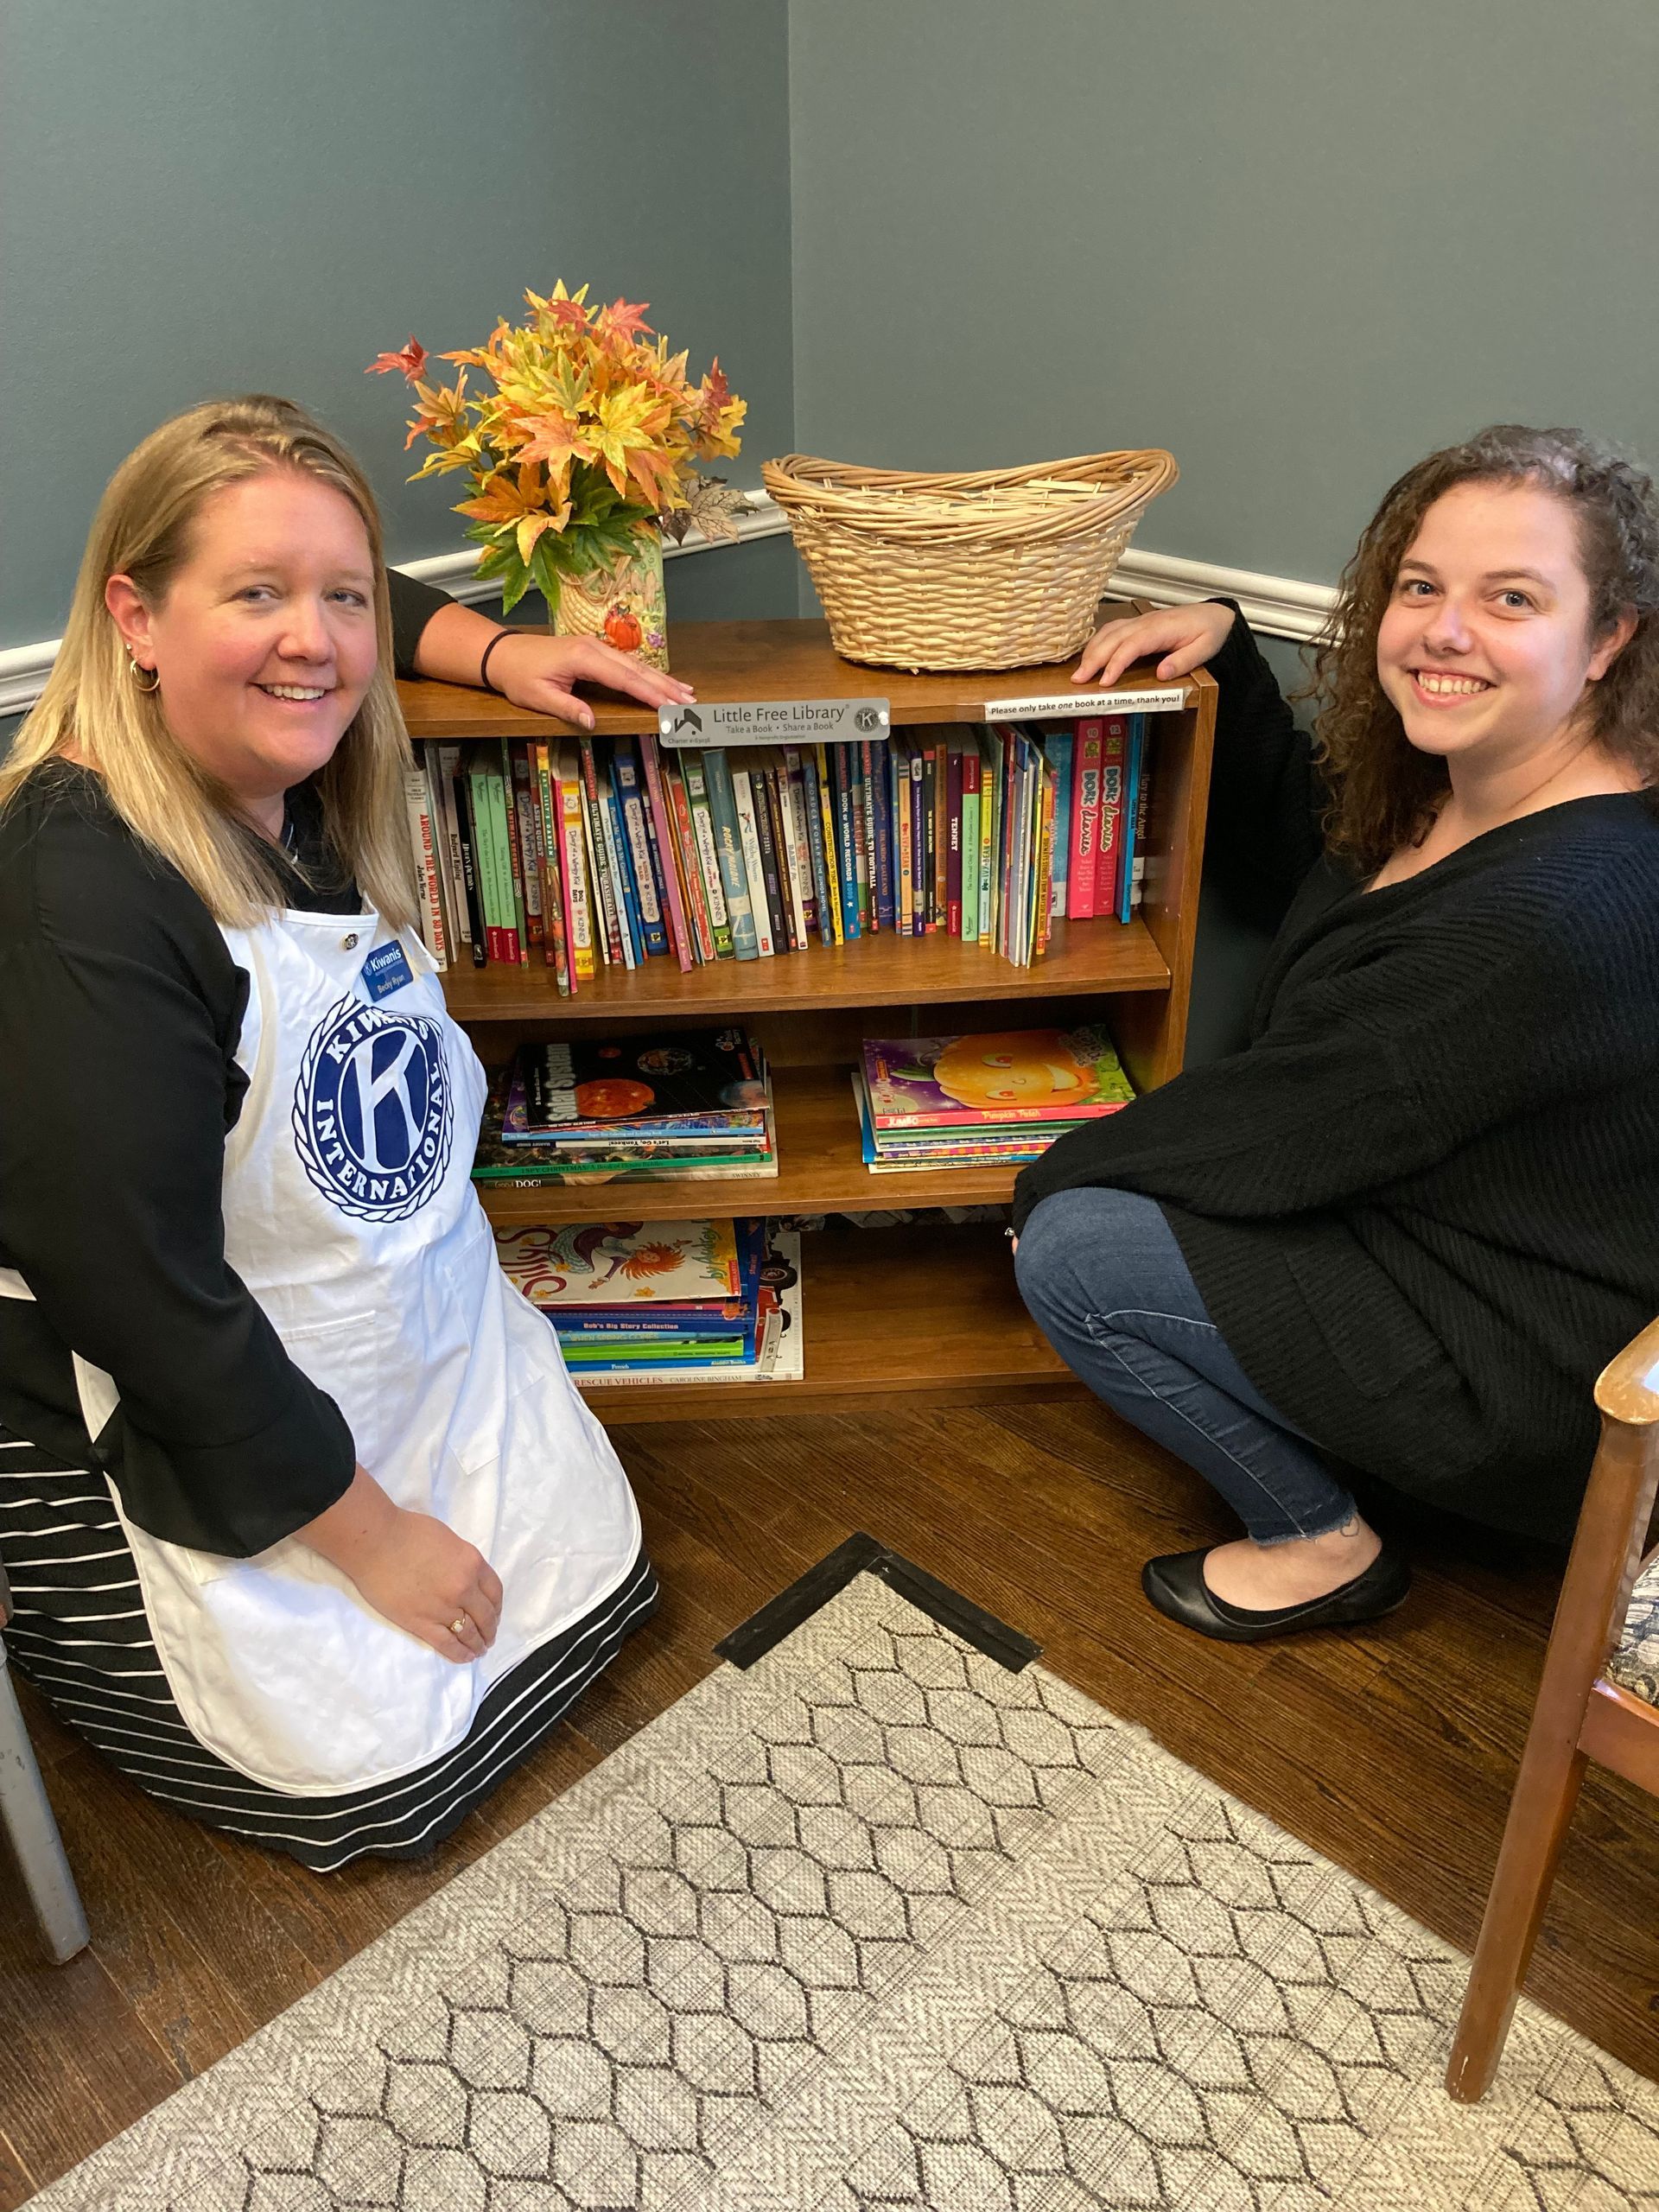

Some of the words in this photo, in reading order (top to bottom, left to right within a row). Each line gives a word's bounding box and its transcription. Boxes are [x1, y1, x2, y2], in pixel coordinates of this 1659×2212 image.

[1161, 695, 1179, 703] you!
[714, 707, 752, 722] Little
[757, 708, 788, 721] Free
[793, 705, 845, 722] Library
[753, 724, 772, 733] Book
[783, 723, 804, 732] Share
[813, 722, 834, 731] Book
[864, 778, 873, 815] ULTIMATE
[1083, 770, 1096, 806] DORK
[1104, 767, 1118, 802] DORK
[520, 795, 531, 818] Diary
[629, 804, 639, 821] Diary
[808, 782, 817, 819] WONDER
[1139, 803, 1148, 816] the
[533, 804, 542, 830] ASH'S
[591, 804, 603, 842] ULTIMATE
[794, 815, 803, 831] Wimpy
[1135, 817, 1147, 840] Angel
[420, 814, 432, 850] AROUND
[569, 830, 578, 847] Diary
[633, 832, 644, 849] Wimpy
[697, 812, 707, 828] Diary
[702, 838, 710, 855] Wimpy
[812, 823, 821, 857] WOMAN
[843, 823, 852, 847] WORLD
[1080, 810, 1096, 855] diaries
[1101, 807, 1119, 852] diaries
[450, 833, 459, 858] Rudyard
[523, 834, 536, 858] Wimpy
[535, 830, 543, 857] QUEST
[597, 843, 606, 866] GUIDE
[826, 822, 836, 870] CONSTRUCTION
[868, 842, 874, 851] TO
[1041, 837, 1050, 859] SIDEWAYS
[424, 852, 435, 873] THE
[527, 859, 537, 872] Kid
[571, 858, 580, 875] Wimpy
[721, 826, 733, 855] ROCKY
[728, 855, 740, 888] MALONE
[453, 859, 461, 880] Kipling
[601, 868, 607, 878] TO
[868, 852, 876, 889] FOOTBALL
[427, 874, 440, 906] WORLD
[801, 871, 810, 896] KINNEY
[531, 885, 539, 910] KINNEY
[602, 880, 614, 917] BASEBALL
[645, 892, 654, 917] KINNEY
[713, 896, 722, 921] KINNEY
[431, 907, 441, 918] IN
[432, 919, 442, 928] 80
[434, 930, 446, 950] DAYS
[577, 917, 586, 944] KINNEY
[370, 948, 402, 972] Kiwanis
[377, 980, 393, 994] Becky
[391, 974, 406, 985] Ryan
[544, 1043, 576, 1089] System
[545, 1090, 578, 1122] Solar
[982, 1110, 1016, 1121] Pumpkin
[316, 1062, 443, 1202] INTERNATIONAL
[887, 1116, 919, 1127] JUMBO
[541, 1165, 586, 1173] CHRISTMAS
[731, 1172, 761, 1180] SWINNEY
[516, 1179, 541, 1188] DOG!
[690, 1227, 723, 1265] Audrey
[699, 1267, 727, 1280] by
[729, 1260, 740, 1291] SCHOLASTIC
[574, 1377, 613, 1387] RESCUE
[615, 1377, 664, 1386] VEHICLES
